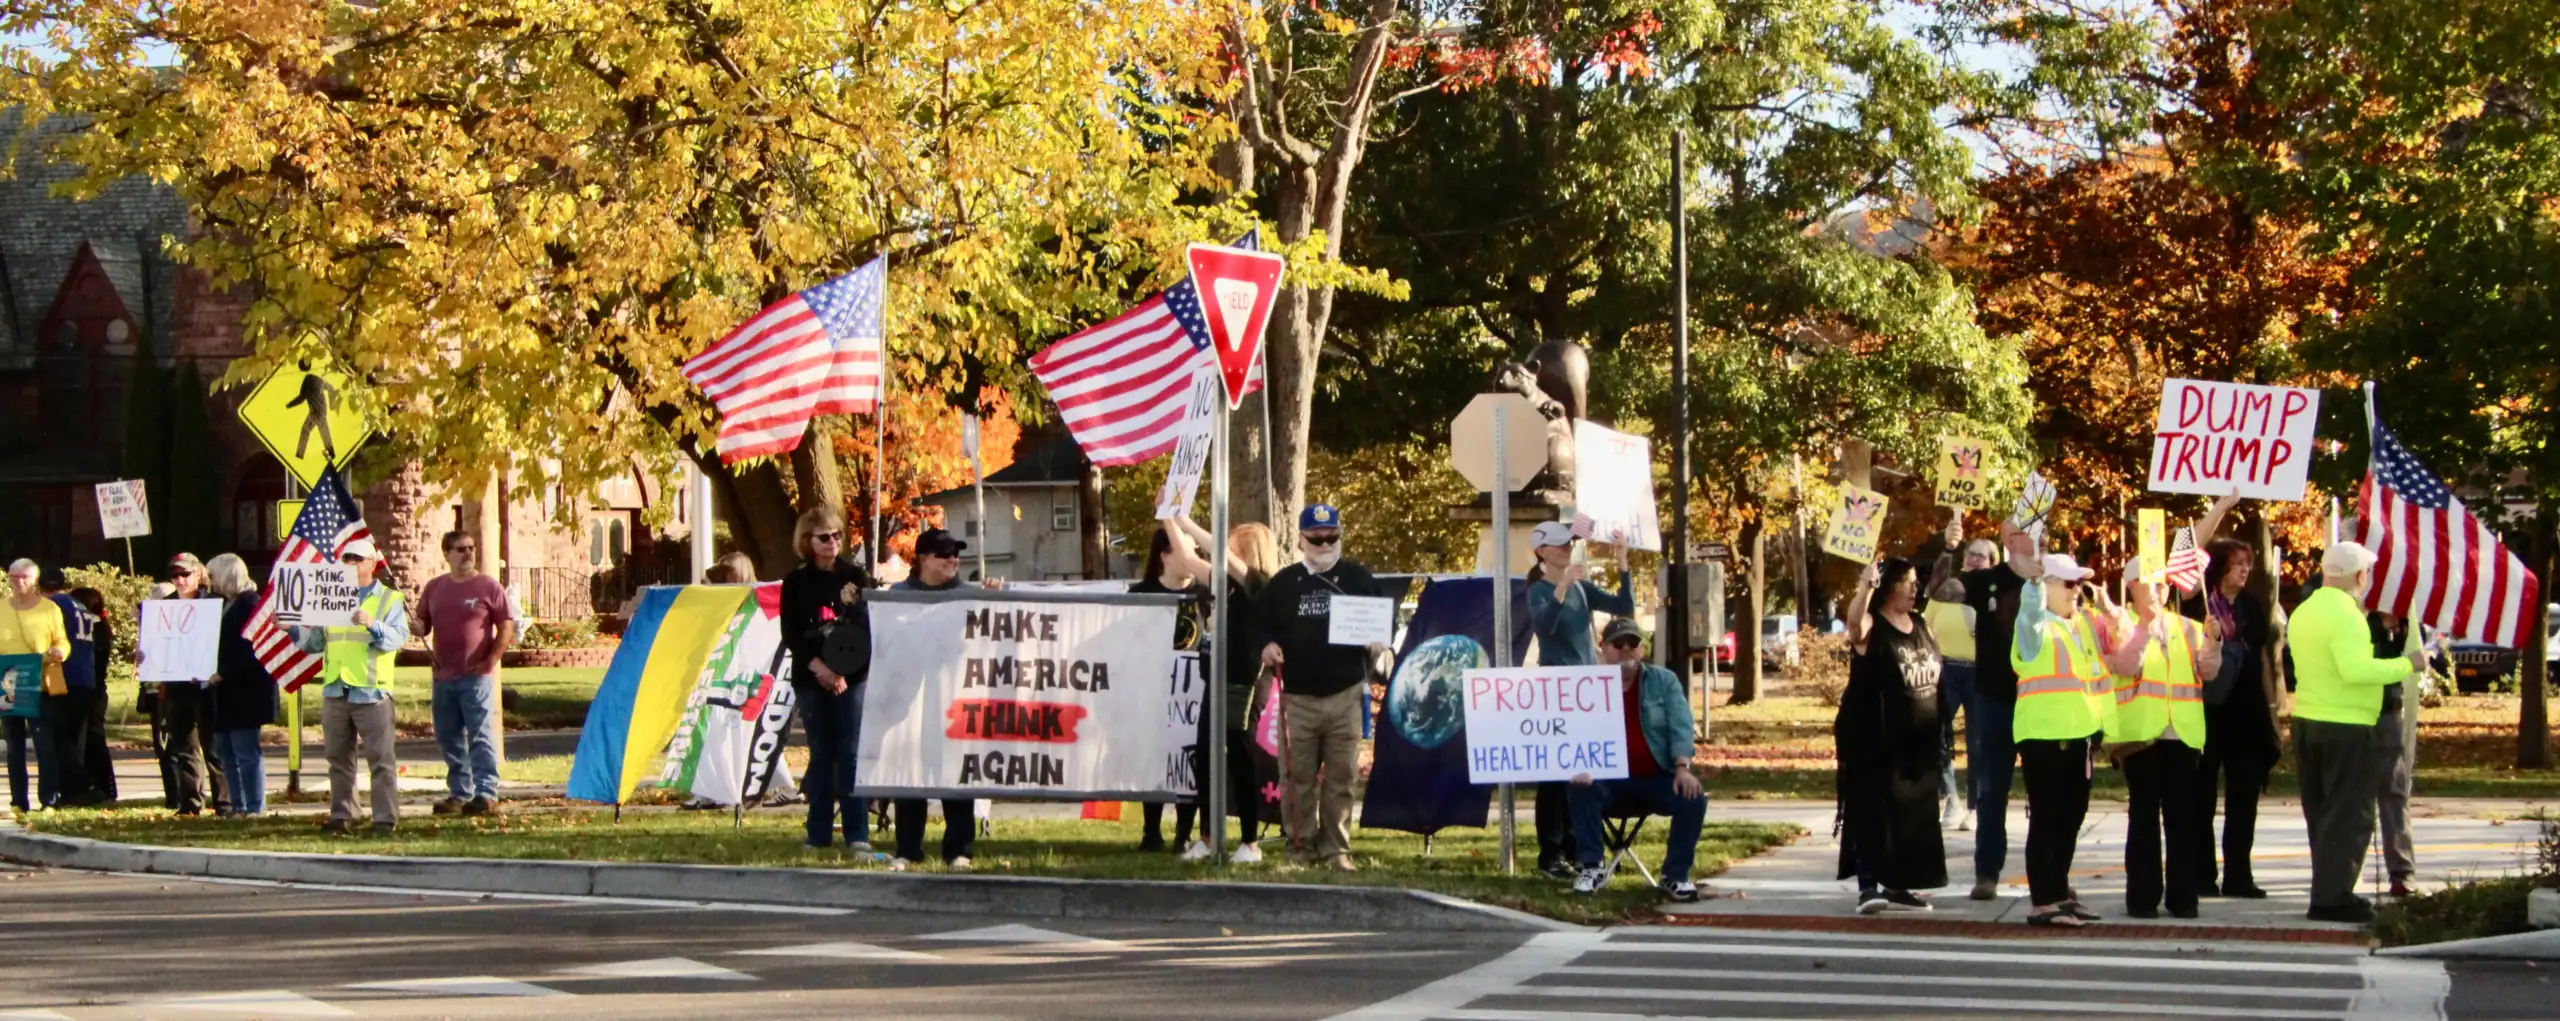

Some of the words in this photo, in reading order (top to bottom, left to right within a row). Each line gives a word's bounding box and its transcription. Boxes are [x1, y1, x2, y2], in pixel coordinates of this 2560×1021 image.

[1190, 376, 1214, 420] NO
[2179, 385, 2308, 436] DUMP
[1171, 432, 1209, 477] KINGS
[2157, 432, 2292, 485] TRUMP
[1937, 490, 1982, 507] KINGS
[1949, 479, 1976, 492] NO
[1830, 536, 1873, 559] KINGS
[1841, 524, 1866, 539] NO
[276, 567, 305, 612] NO
[158, 603, 197, 634] NO
[965, 608, 1059, 642] MAKE
[963, 656, 1110, 692] AMERICA
[1471, 676, 1614, 712] PROTECT
[745, 647, 797, 796] EEDOM
[963, 703, 1064, 740] THINK
[1520, 718, 1567, 736] OUR
[959, 751, 1065, 786] AGAIN
[1473, 744, 1548, 771] HEALTH
[1557, 741, 1617, 770] CARE
